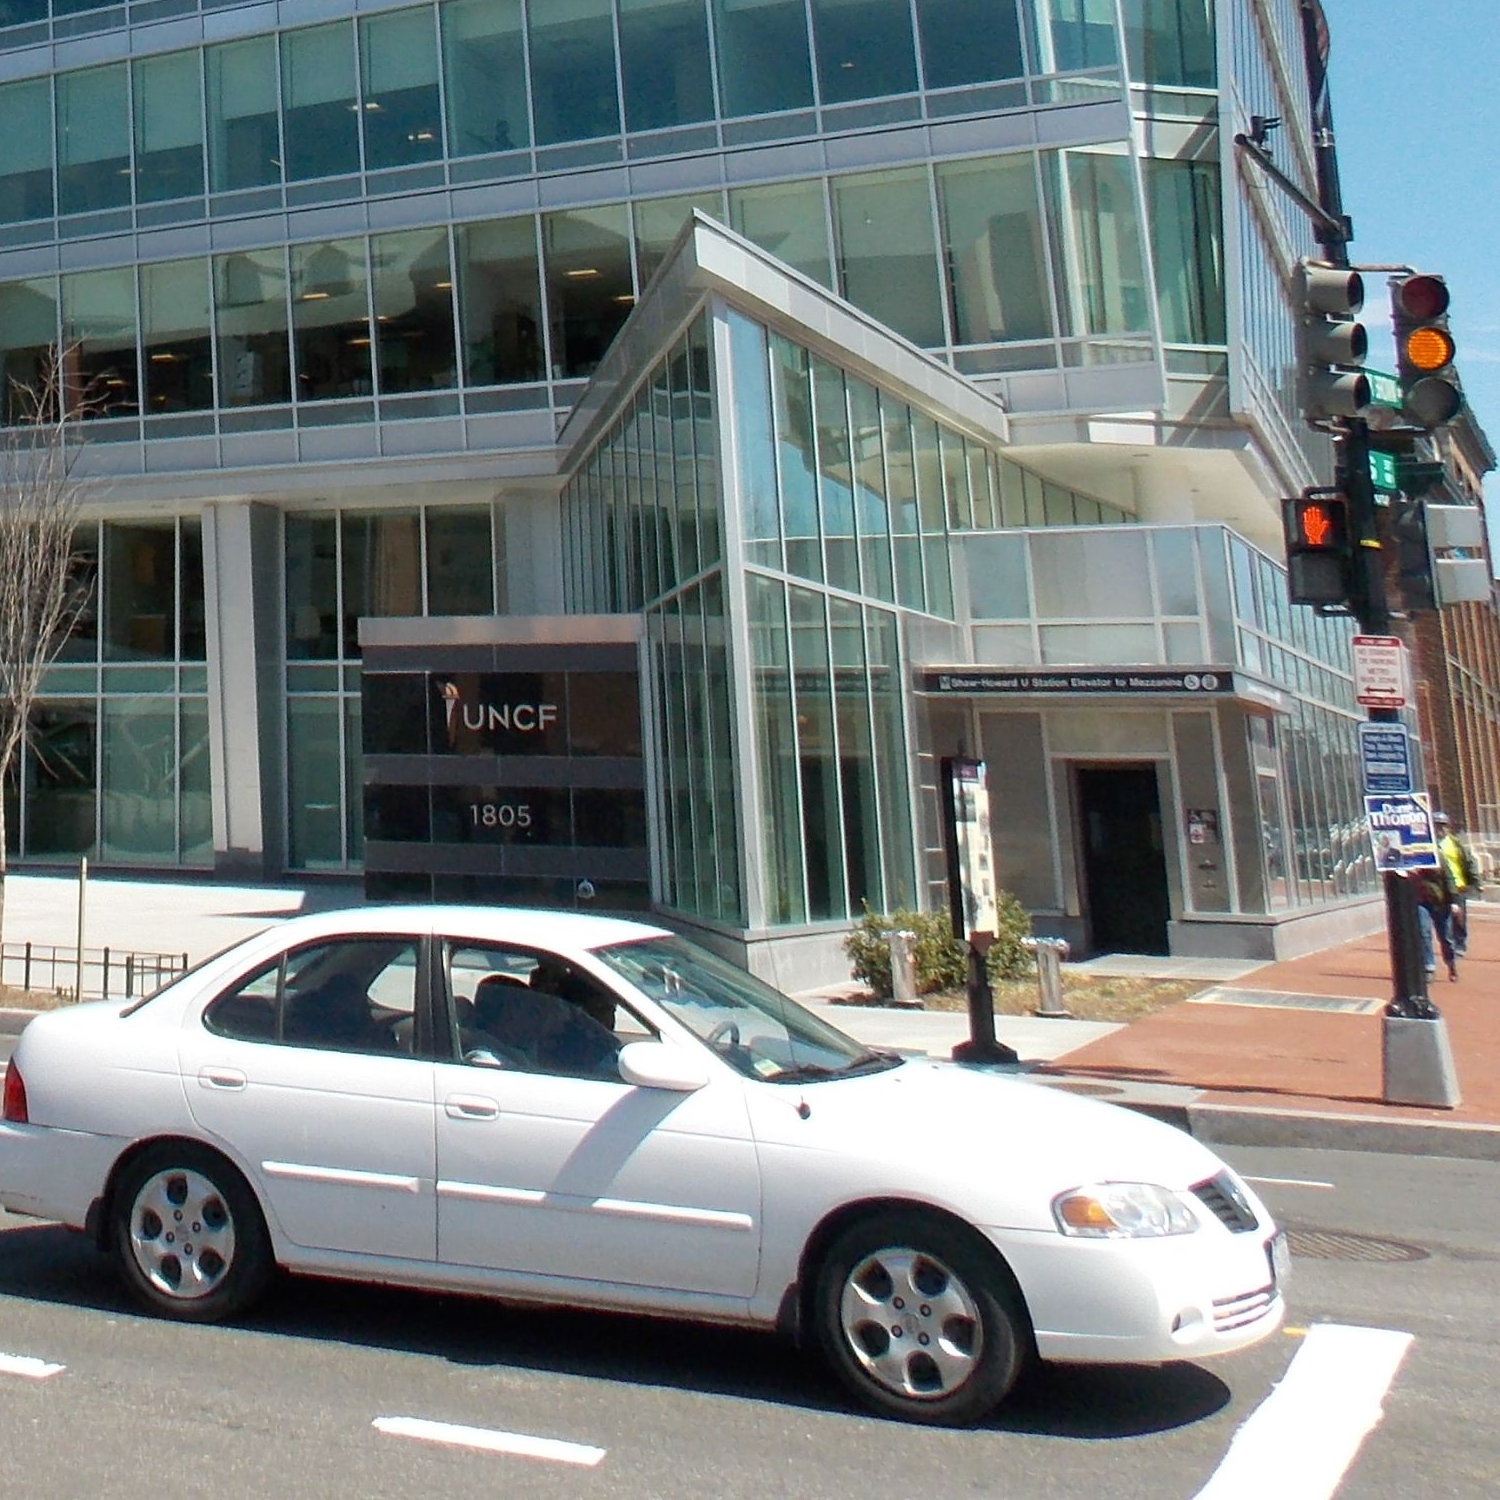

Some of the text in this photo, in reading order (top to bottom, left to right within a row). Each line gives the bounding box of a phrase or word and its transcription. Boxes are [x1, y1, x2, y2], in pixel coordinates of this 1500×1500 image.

[951, 677, 1019, 688] Shaw-Howard
[1020, 677, 1029, 688] U
[1032, 677, 1069, 688] Station
[1070, 677, 1112, 688] Elevator
[1115, 678, 1127, 687] to
[1129, 678, 1183, 688] Mezzanine
[463, 703, 558, 731] UNCF
[470, 804, 531, 826] 1805
